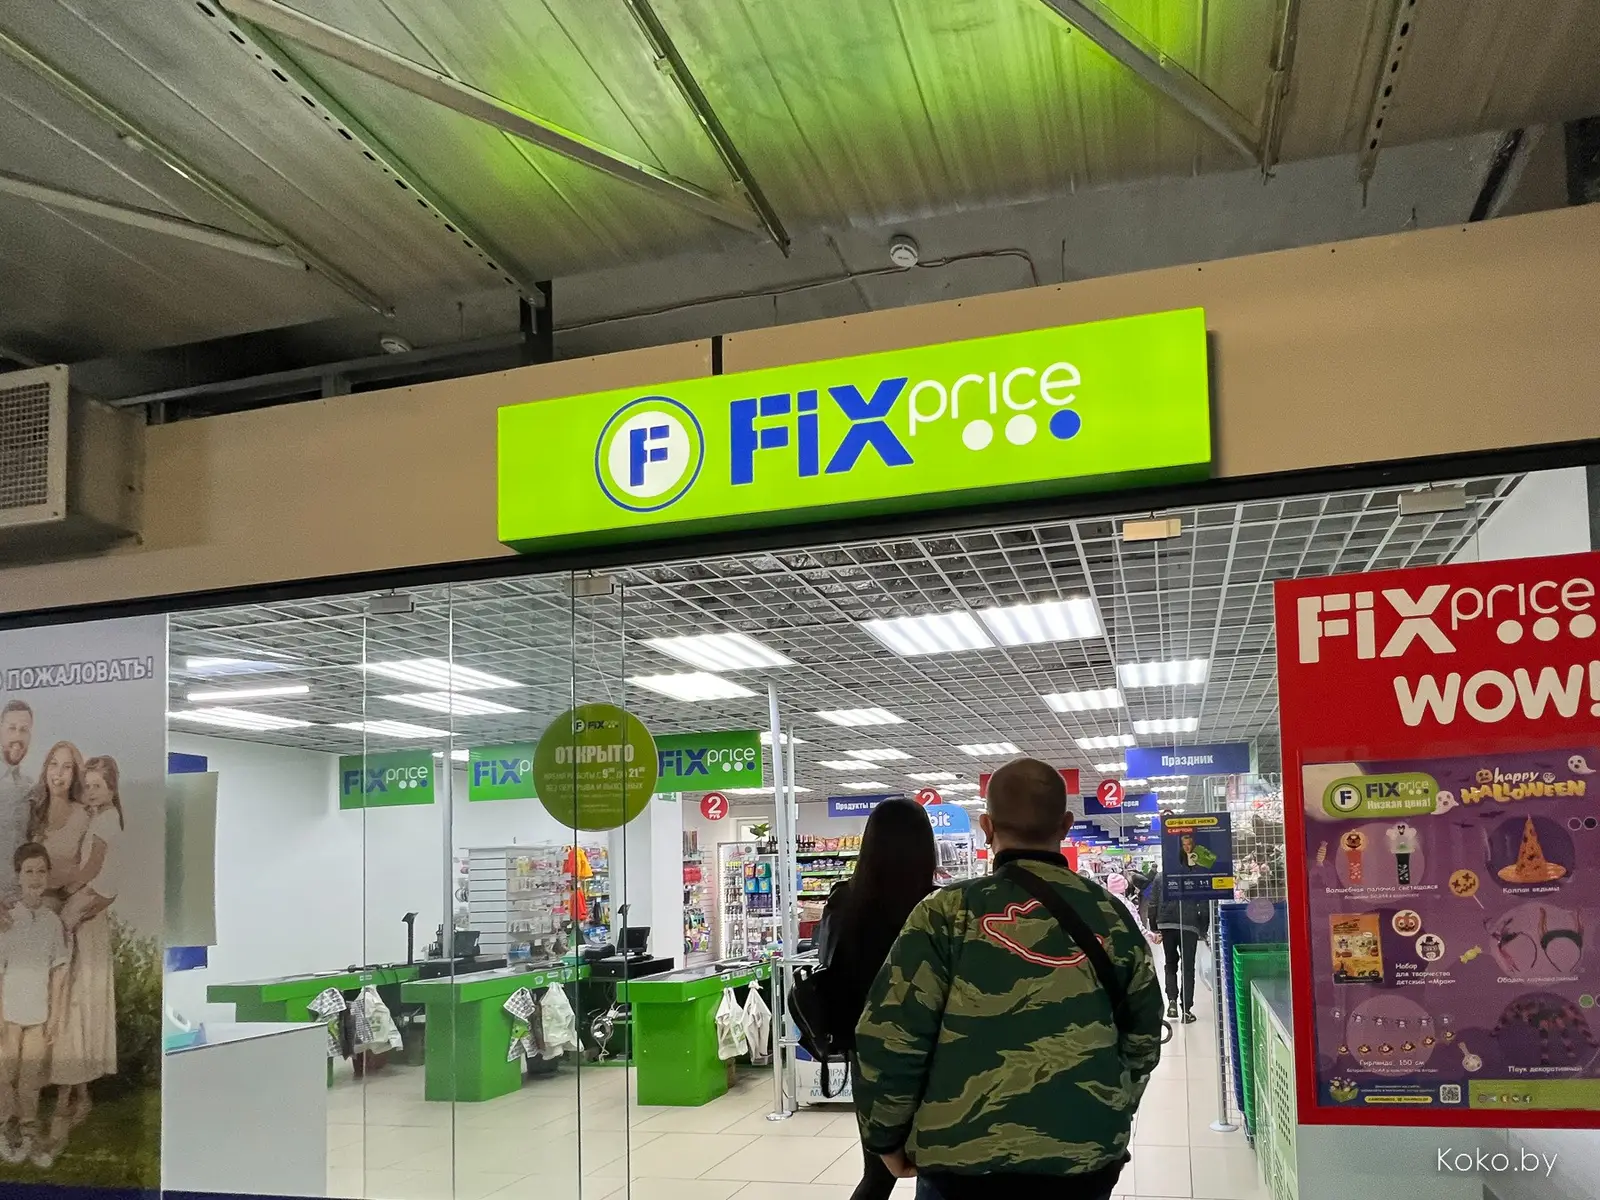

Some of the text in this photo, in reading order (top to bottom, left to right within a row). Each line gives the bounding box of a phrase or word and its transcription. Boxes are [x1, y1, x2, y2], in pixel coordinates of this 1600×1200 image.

[907, 360, 1082, 437] price
[1450, 577, 1596, 631] price
[6, 656, 154, 691] ПОЖАЛОВАТЬ!
[1393, 659, 1600, 727] WOW!
[707, 747, 756, 767] price
[1161, 755, 1214, 768] Праздник
[385, 766, 429, 784] price
[1493, 767, 1539, 784] happy
[1103, 782, 1118, 801] 2
[1460, 780, 1586, 804] HALLOWEEN
[707, 795, 722, 814] 2
[835, 802, 869, 811] Продукты
[1367, 798, 1402, 810] Низкая
[928, 811, 952, 827] bit
